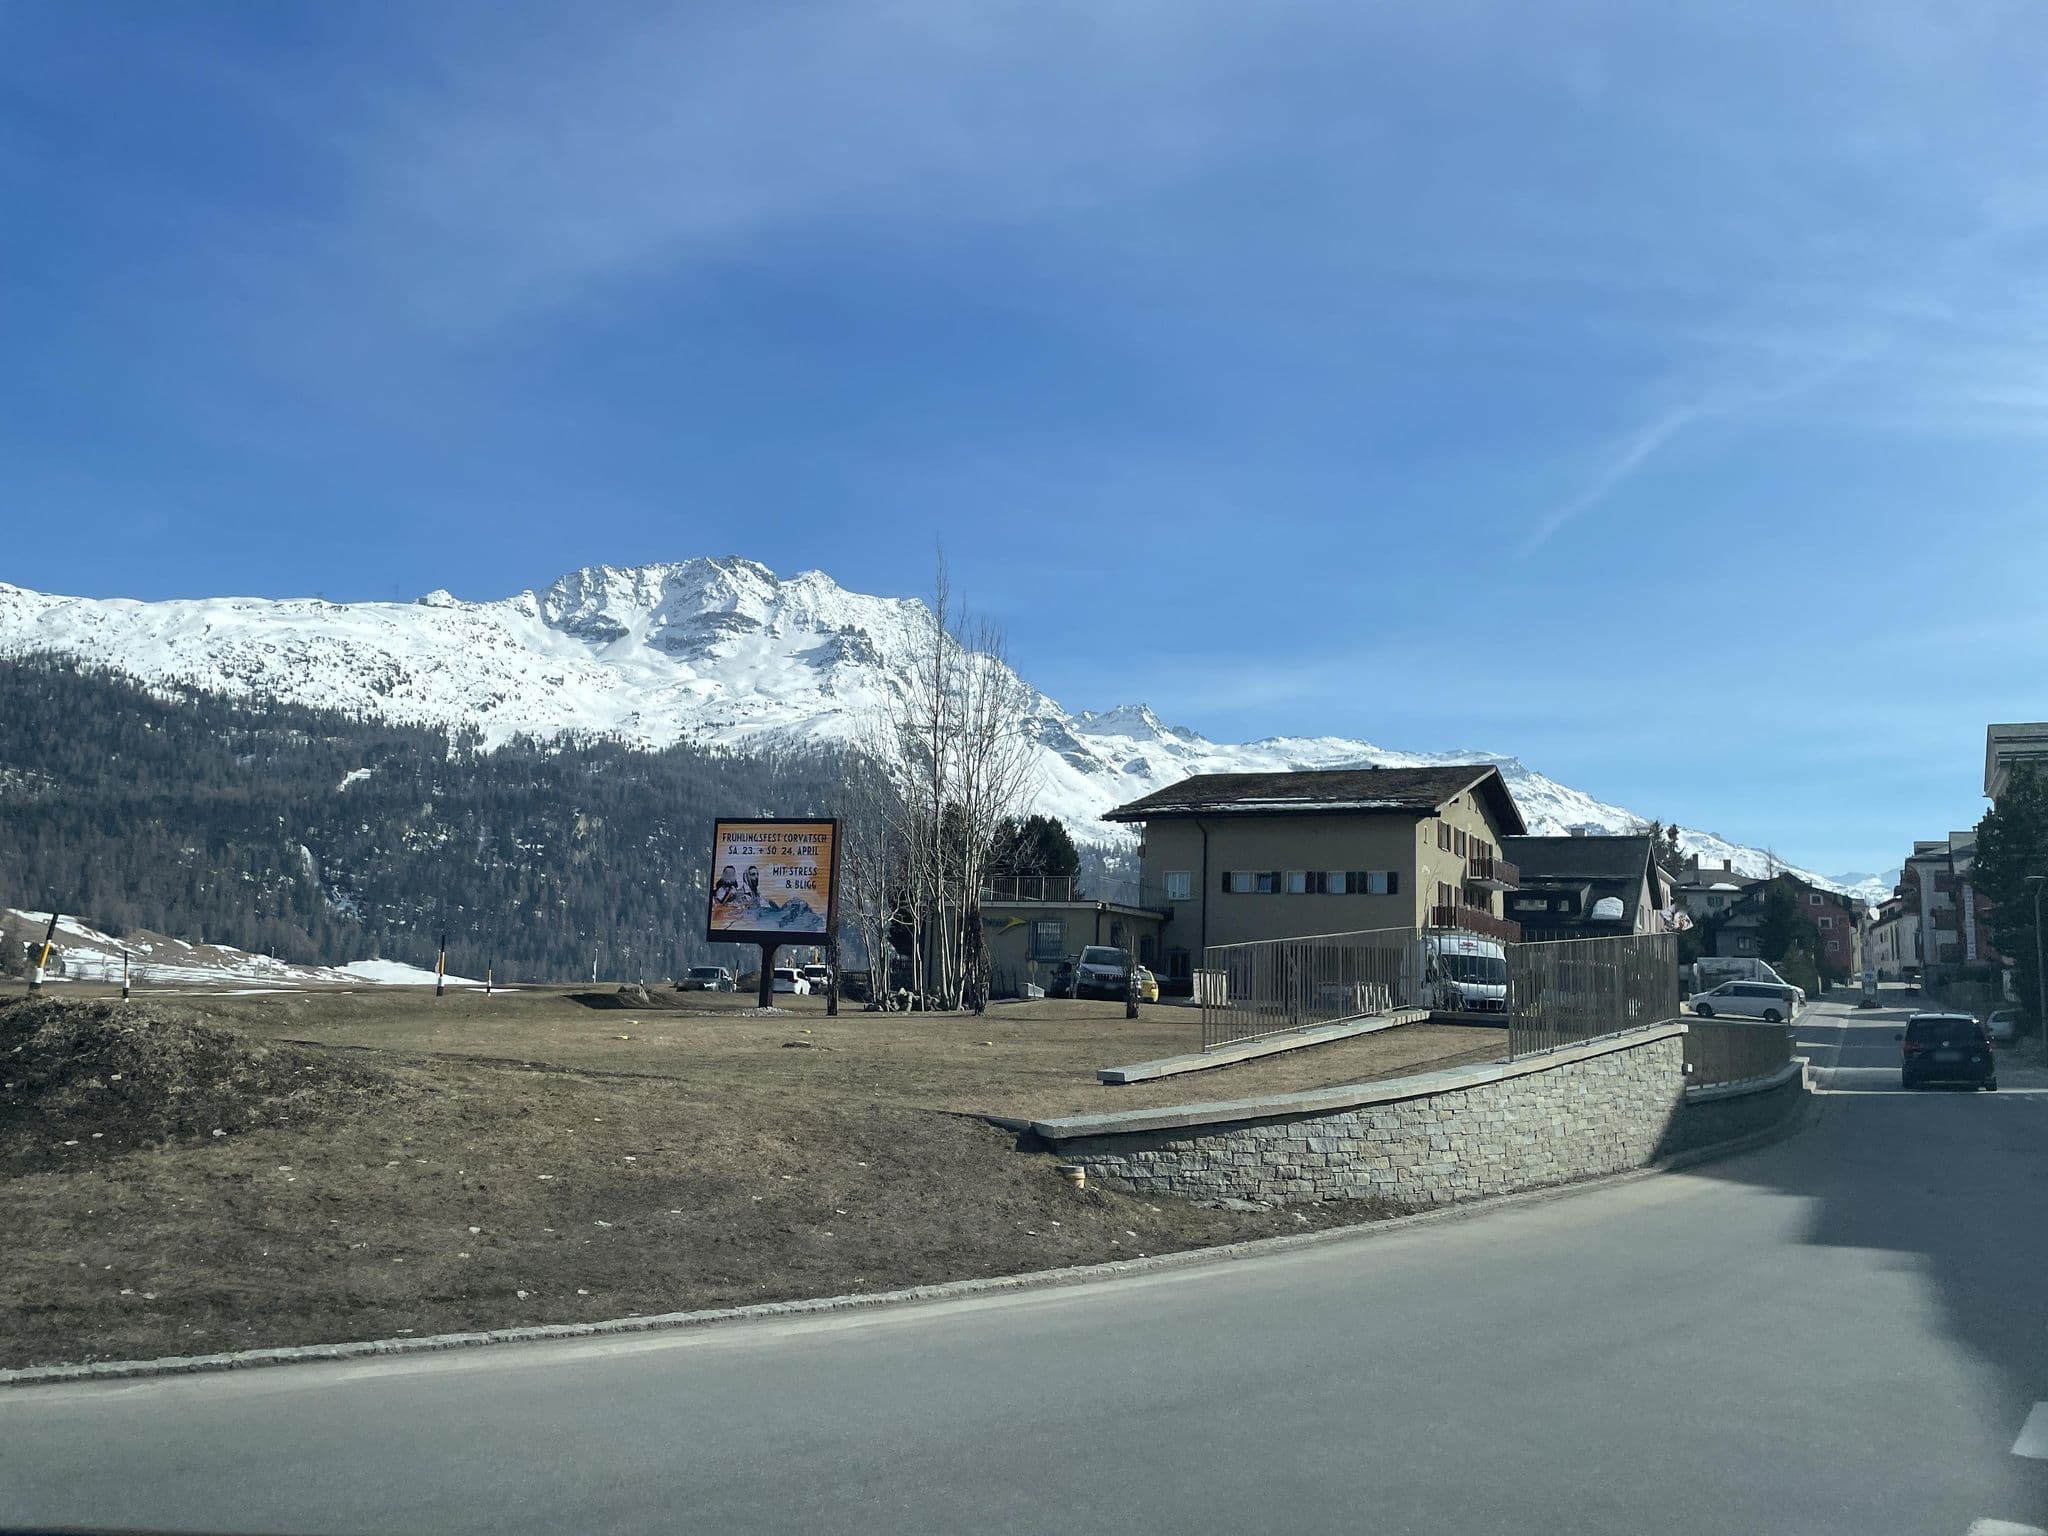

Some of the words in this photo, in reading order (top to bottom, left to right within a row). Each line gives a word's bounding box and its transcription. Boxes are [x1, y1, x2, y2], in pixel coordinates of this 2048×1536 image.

[783, 833, 827, 843] CORVATSCH
[742, 846, 756, 855] 23.
[781, 846, 796, 856] 24.
[797, 846, 819, 856] APRIL
[772, 866, 786, 876] MIT
[788, 866, 818, 876] STRESS
[785, 880, 793, 889] &
[794, 880, 817, 889] BLIGG
